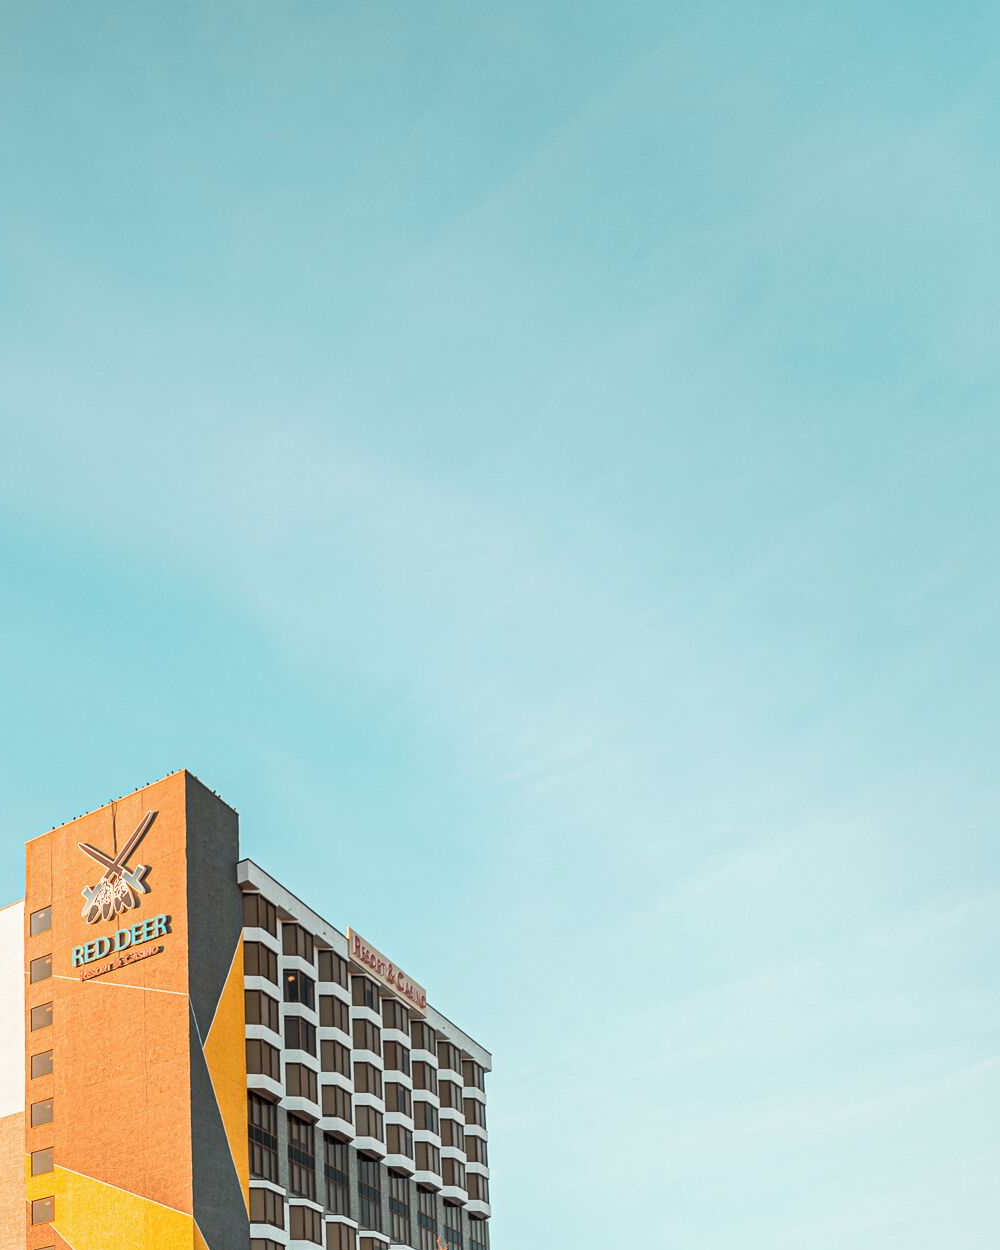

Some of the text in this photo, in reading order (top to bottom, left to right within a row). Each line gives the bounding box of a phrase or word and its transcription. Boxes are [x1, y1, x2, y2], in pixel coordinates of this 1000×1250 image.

[72, 914, 167, 968] RED DEER
[386, 963, 396, 984] &
